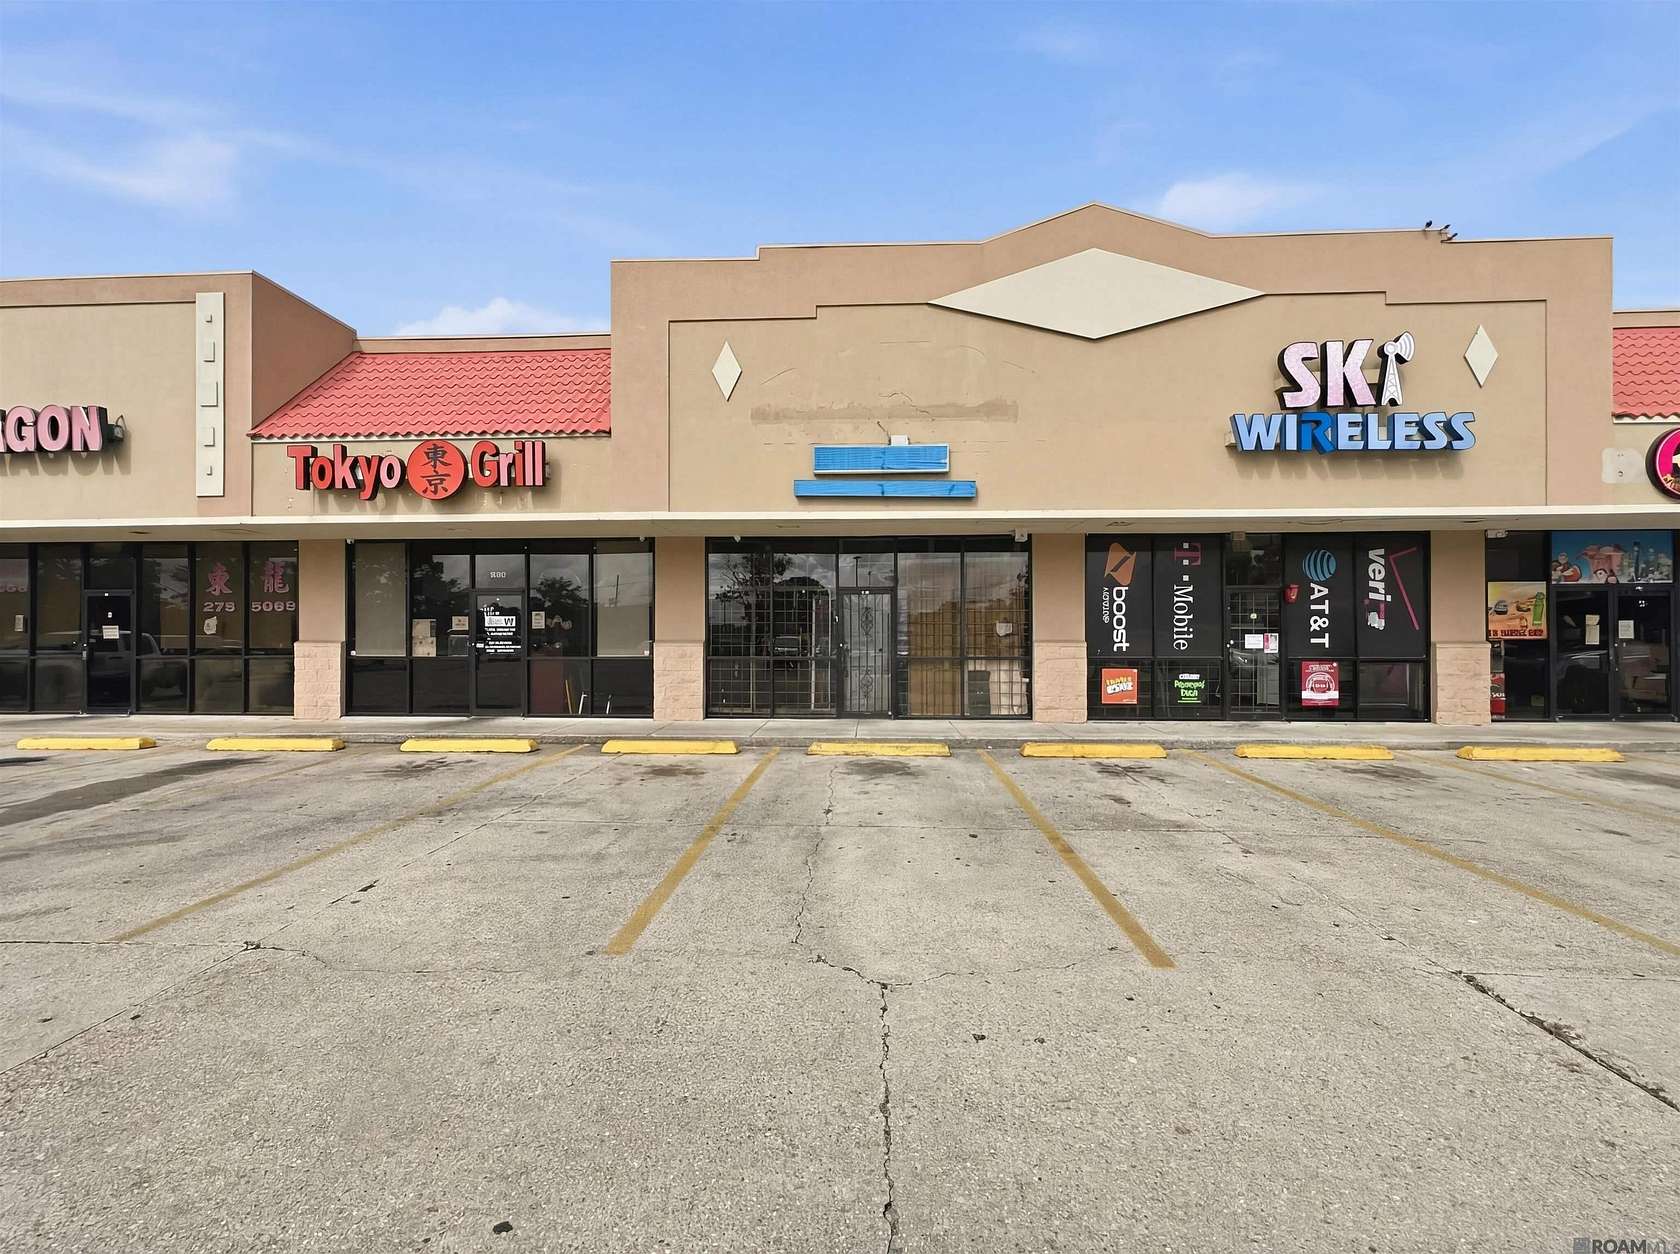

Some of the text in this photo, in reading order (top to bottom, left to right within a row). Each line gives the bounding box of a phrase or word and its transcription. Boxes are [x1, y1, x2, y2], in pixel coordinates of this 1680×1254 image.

[0, 404, 106, 453] GON
[1231, 411, 1476, 454] WIRELESS
[286, 439, 546, 500] Tokyo Grill
[420, 443, 453, 495] 東京
[1112, 586, 1130, 652] boost
[1309, 582, 1330, 649] AT&T
[1367, 548, 1392, 630] veri
